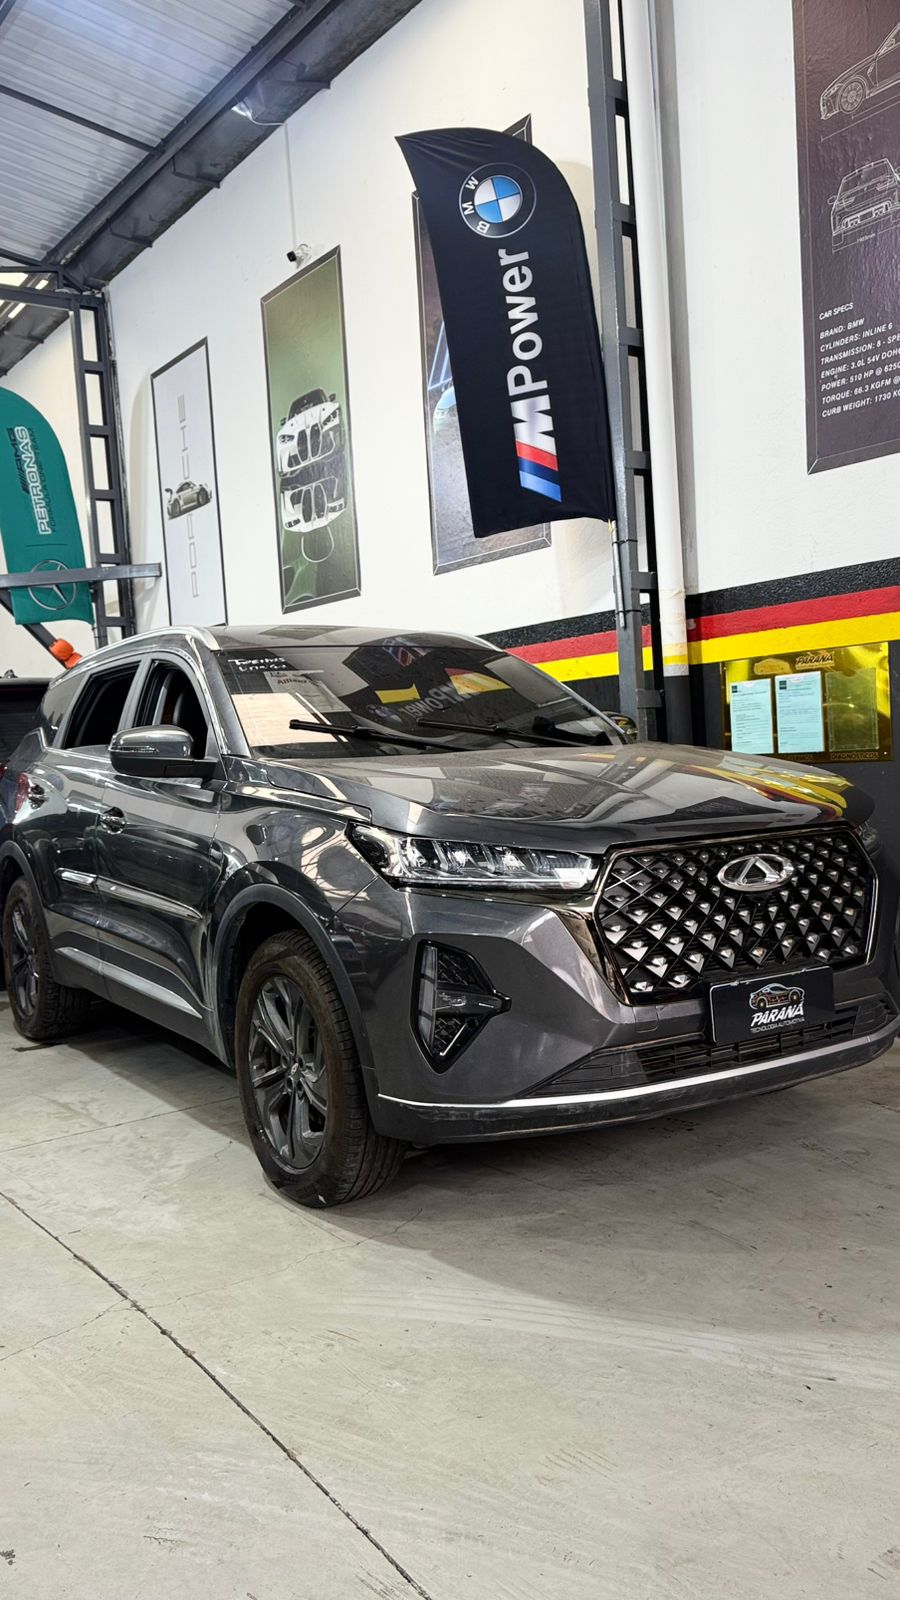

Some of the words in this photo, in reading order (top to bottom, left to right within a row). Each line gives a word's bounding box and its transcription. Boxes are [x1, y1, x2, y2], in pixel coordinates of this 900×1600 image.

[461, 175, 491, 234] BMW
[819, 310, 832, 320] CAR
[833, 302, 854, 316] SPECS
[820, 325, 846, 339] BRAND:
[847, 318, 864, 330] BMW
[820, 334, 860, 352] CYLINDERS:
[862, 324, 887, 338] INLINE
[888, 322, 893, 330] 6
[820, 343, 875, 365] TRANSMISSION:
[821, 364, 849, 379] ENGINE:
[851, 359, 866, 369] 3.0L
[867, 354, 880, 364] 54V
[821, 378, 848, 392] POWER:
[850, 373, 862, 384] 510
[864, 370, 874, 379] HP
[875, 367, 882, 376] @
[822, 390, 853, 405] TORQUE:
[870, 378, 891, 390] KGFM
[822, 406, 841, 418] CURB
[842, 397, 872, 412] WEIGHT:
[875, 392, 891, 403] 1730
[14, 426, 51, 534] PETRONAS
[177, 394, 199, 597] PORCHE
[750, 1001, 804, 1027] PARANÁ
